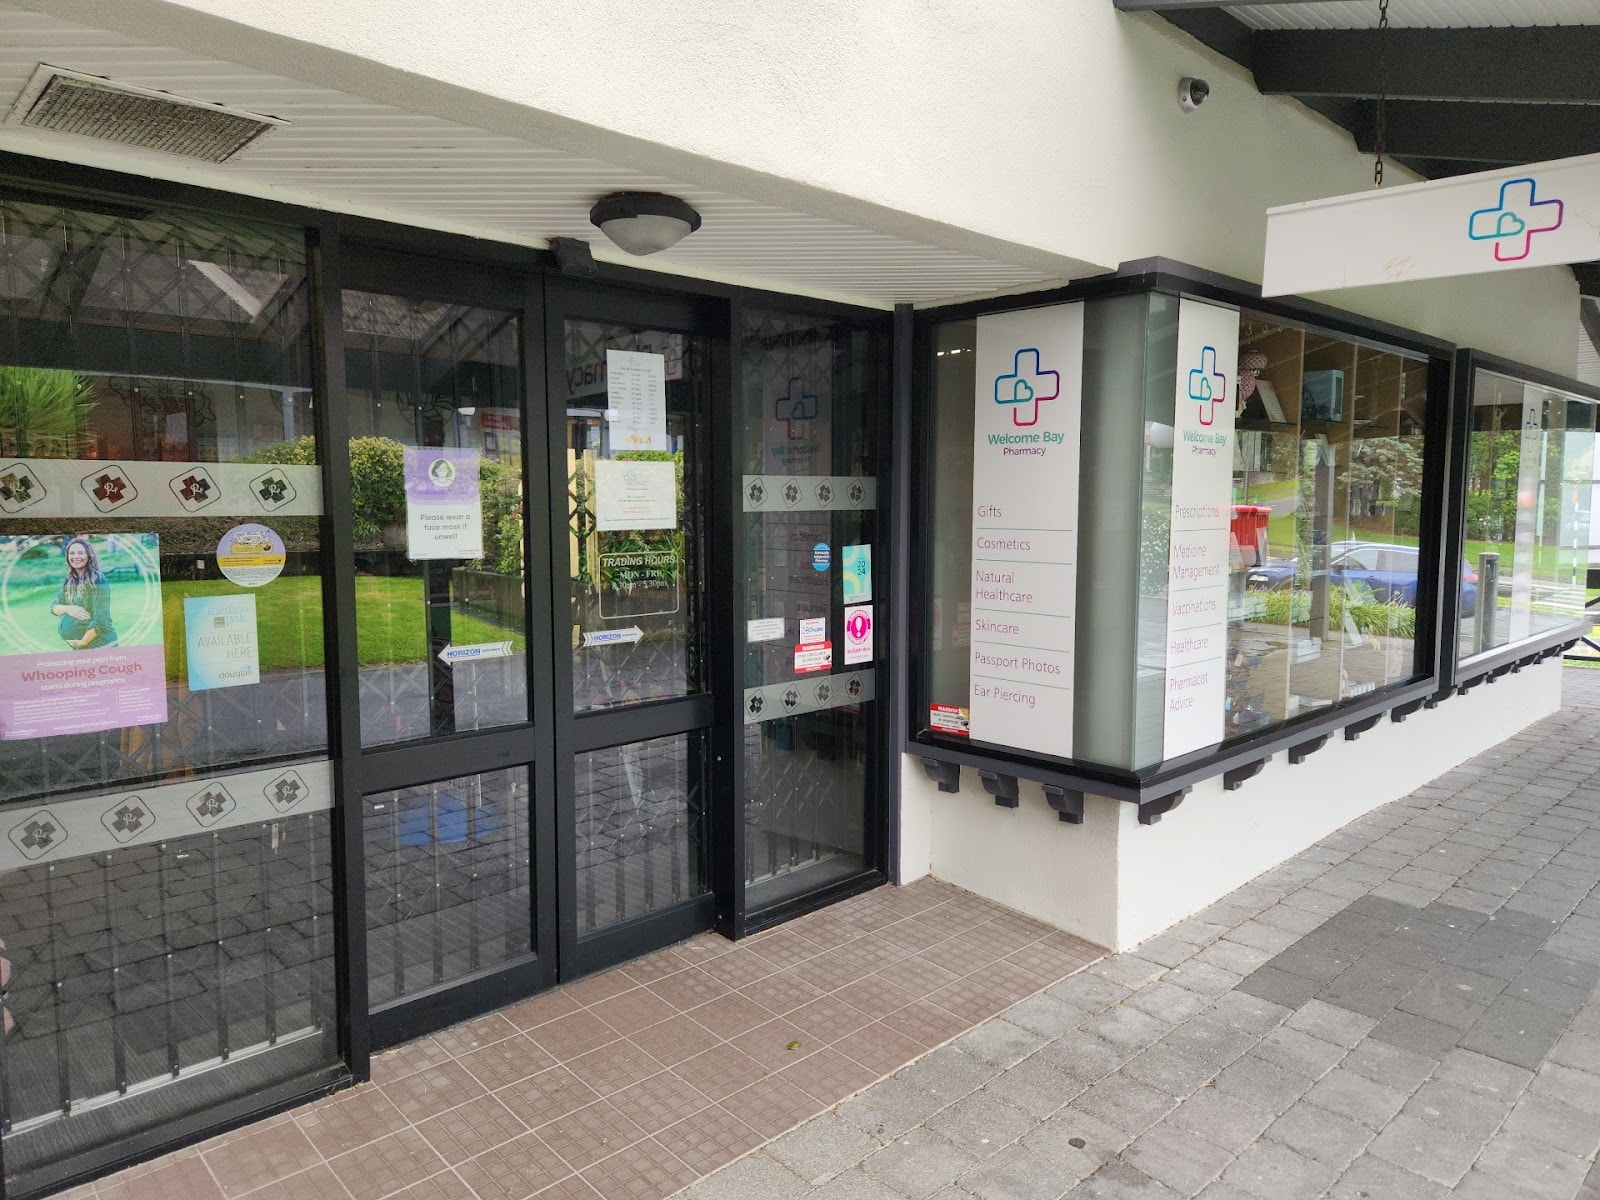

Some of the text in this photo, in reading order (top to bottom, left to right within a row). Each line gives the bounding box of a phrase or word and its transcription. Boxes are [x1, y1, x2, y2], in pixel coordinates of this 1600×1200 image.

[988, 432, 1065, 444] Welcome Bay
[1183, 430, 1227, 447] Welcome Bay
[1003, 447, 1047, 456] Pharmacy
[1192, 446, 1216, 457] Pharmacy
[977, 505, 1002, 517] Gifts
[1175, 504, 1219, 521] Prescriptions
[977, 537, 1031, 551] Cosmetics
[1173, 543, 1207, 559] Medicine
[602, 555, 676, 567] TRADING HOURS
[857, 560, 866, 568] 20
[620, 570, 640, 579] MON
[646, 569, 660, 577] FRI
[857, 568, 866, 576] 24
[976, 570, 1015, 584] Natural
[1173, 563, 1220, 581] Management
[976, 588, 1033, 603] Healthcare
[1172, 599, 1217, 616] Vaccinations
[975, 619, 1020, 634] Skincare
[197, 631, 252, 648] AVAILABLE
[594, 633, 621, 641] HORIZON
[226, 646, 253, 660] HERE
[447, 648, 480, 658] HORIZON
[1170, 637, 1209, 655] Healthcare
[975, 651, 1061, 675] Passport Photos
[21, 662, 142, 682] Whooping Cough
[218, 669, 253, 681] douglas
[1170, 673, 1209, 692] Pharmacist
[974, 684, 1036, 708] Ear Piercing
[1169, 695, 1194, 713] Advice
